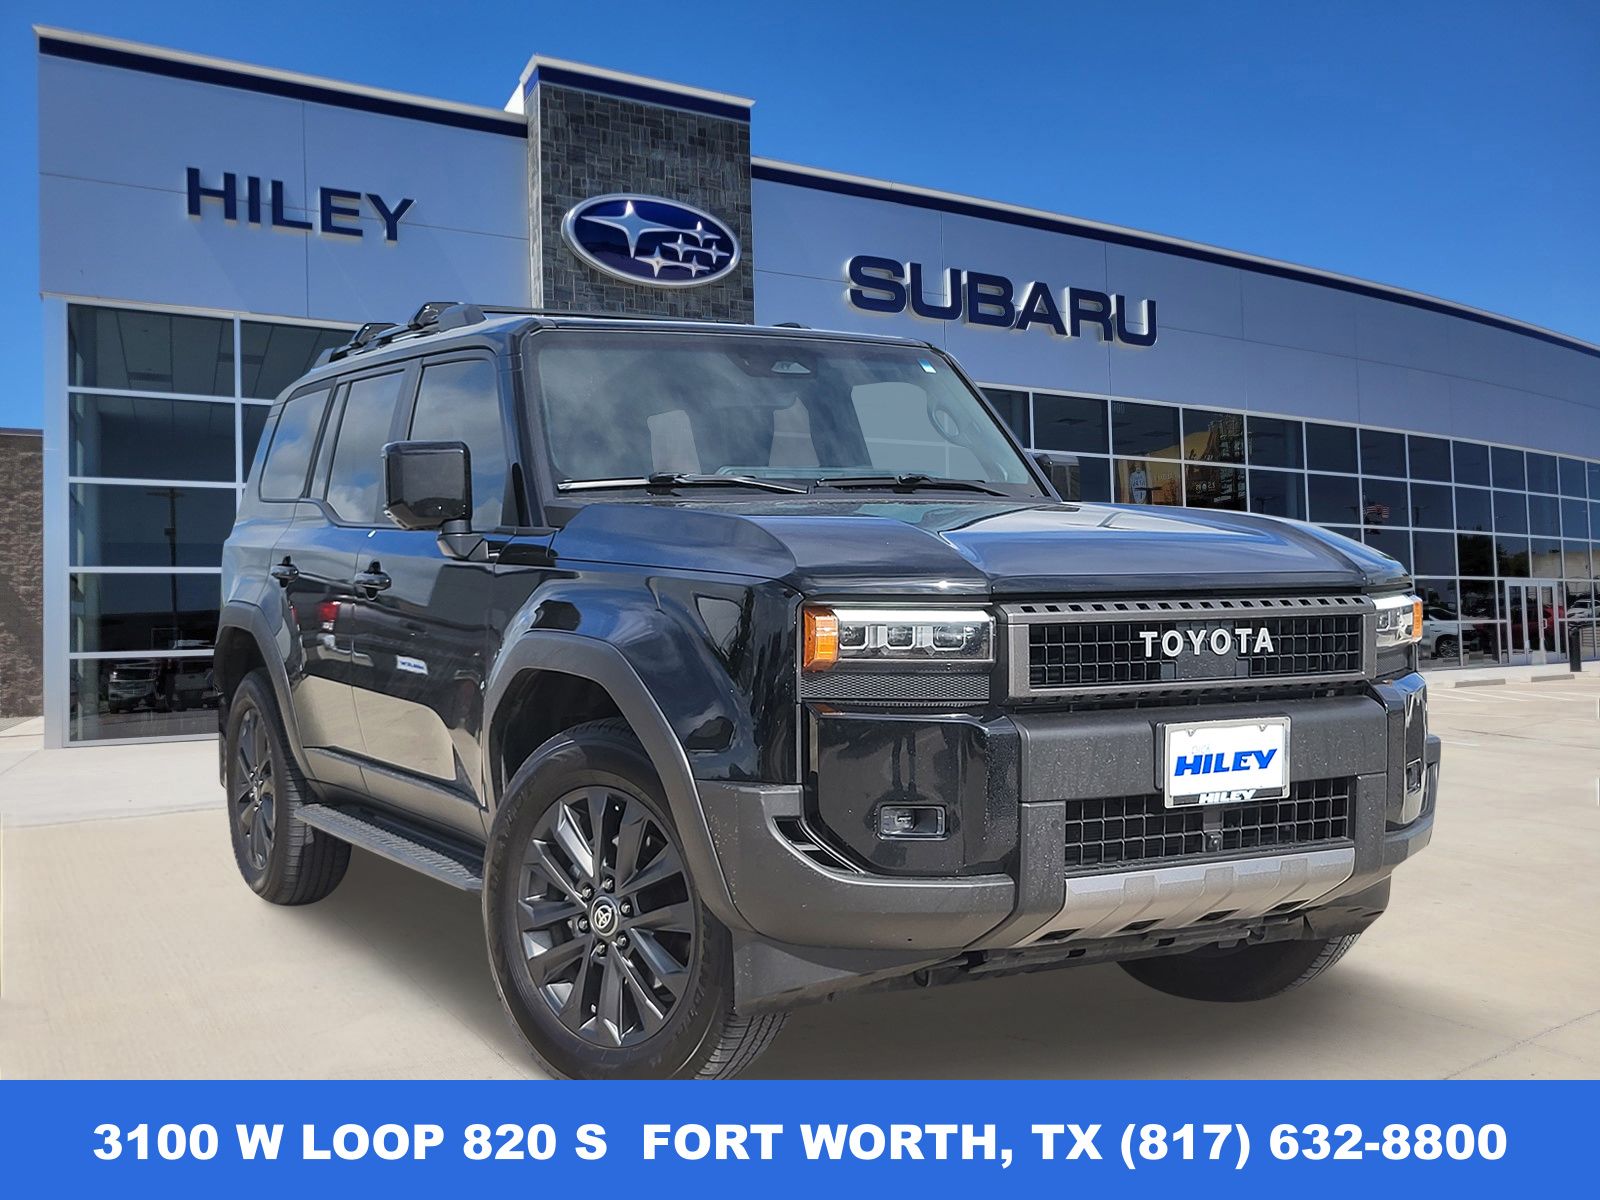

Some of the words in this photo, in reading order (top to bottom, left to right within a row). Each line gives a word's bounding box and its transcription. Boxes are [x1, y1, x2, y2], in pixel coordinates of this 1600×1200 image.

[186, 167, 415, 242] HILEY
[847, 255, 1157, 347] SUBARU
[1138, 627, 1275, 658] TOYOTA
[1174, 748, 1278, 777] HILEY
[1198, 789, 1257, 805] HILEY
